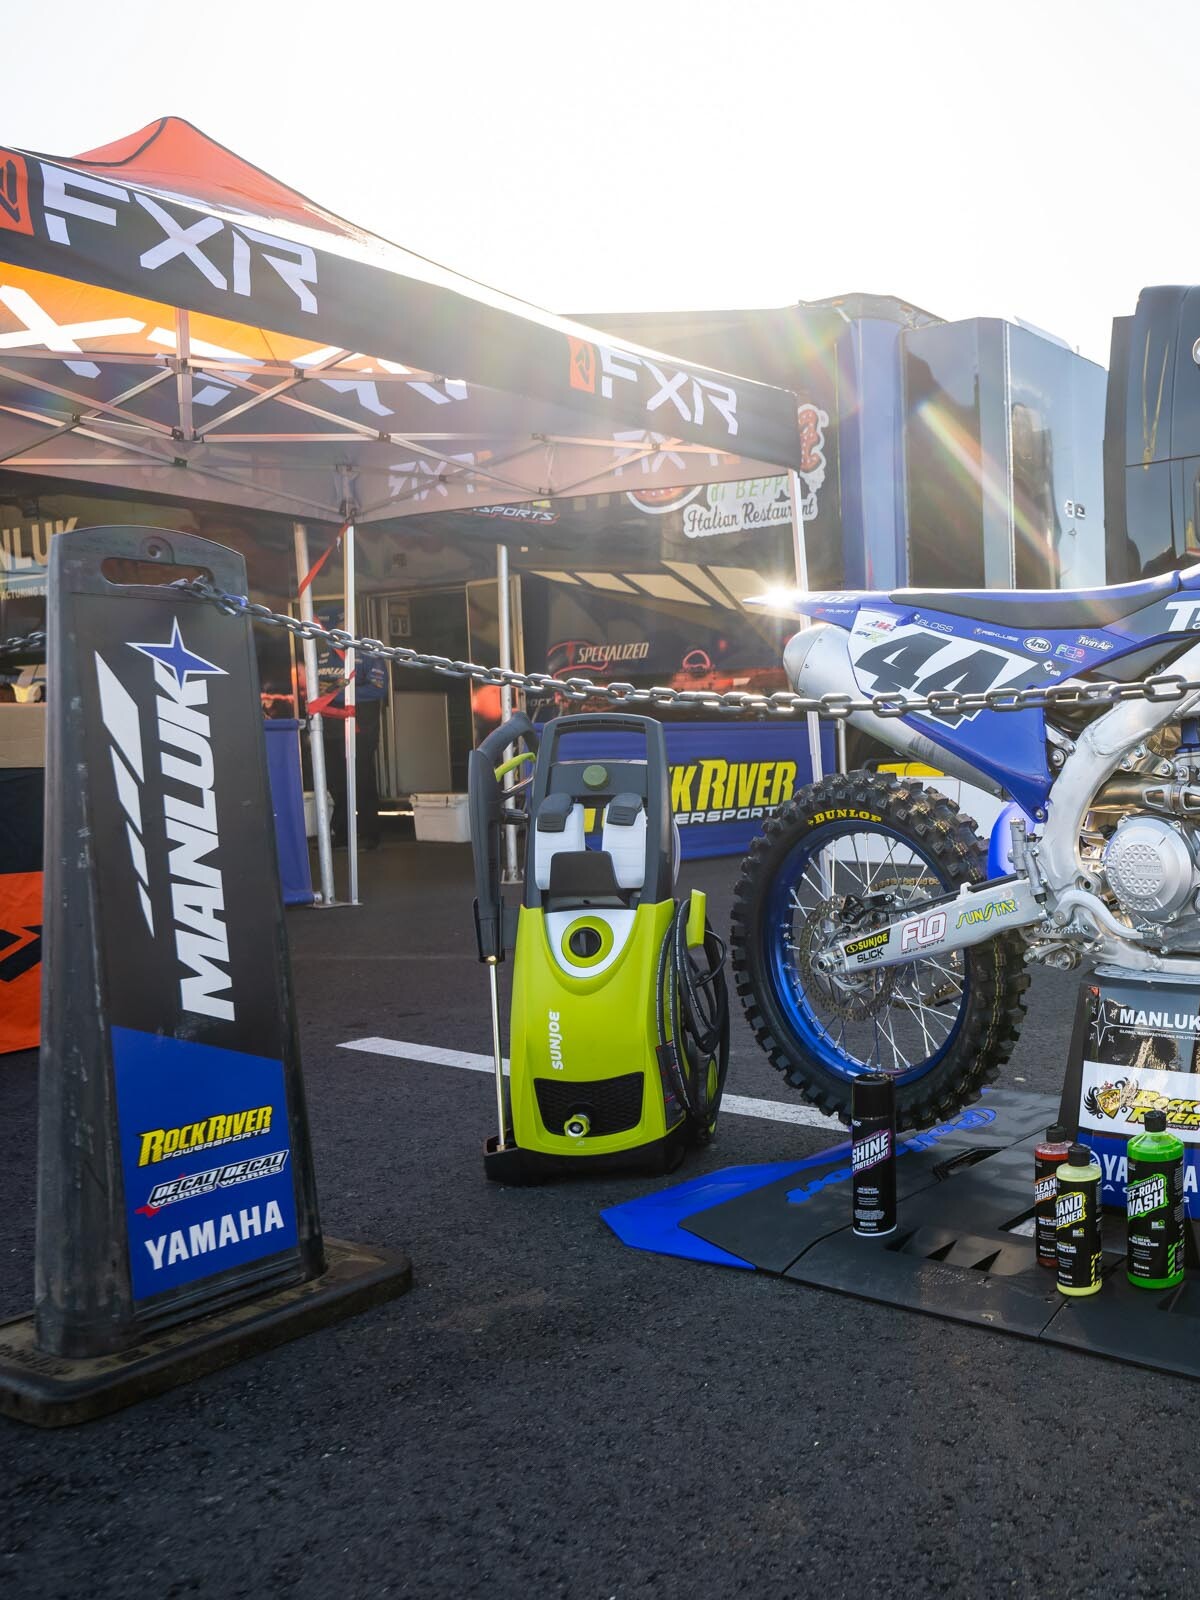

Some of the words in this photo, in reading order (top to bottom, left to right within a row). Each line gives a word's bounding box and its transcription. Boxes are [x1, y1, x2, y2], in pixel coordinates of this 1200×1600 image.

[39, 161, 318, 314] FXR
[600, 343, 739, 435] FXR
[473, 506, 555, 521] SPORTS
[687, 505, 740, 533] Italian
[742, 497, 815, 525] Restaurnt
[577, 642, 650, 664] SPECIALIZED
[854, 631, 1009, 728] 44
[674, 806, 780, 824] ERSPORT
[814, 808, 882, 825] DUNLOP
[153, 658, 236, 1022] MANLUK
[956, 898, 1019, 930] SUNSTAR
[857, 932, 889, 951] SUNJOE
[552, 1010, 564, 1071] SUNJOE
[162, 1127, 271, 1161] POWERSPORTS
[852, 1132, 889, 1165] SHINE
[220, 1166, 282, 1187] WORKS
[223, 1152, 286, 1178] DECAL
[1103, 1154, 1198, 1193] YAA
[151, 1184, 215, 1208] WORKS
[153, 1170, 218, 1199] DECAL
[1035, 1175, 1057, 1196] CLEAN
[1127, 1178, 1164, 1202] FF-ROAD
[1127, 1189, 1165, 1217] WASH
[1056, 1209, 1083, 1227] LEANER
[144, 1200, 285, 1271] YAMAHA
